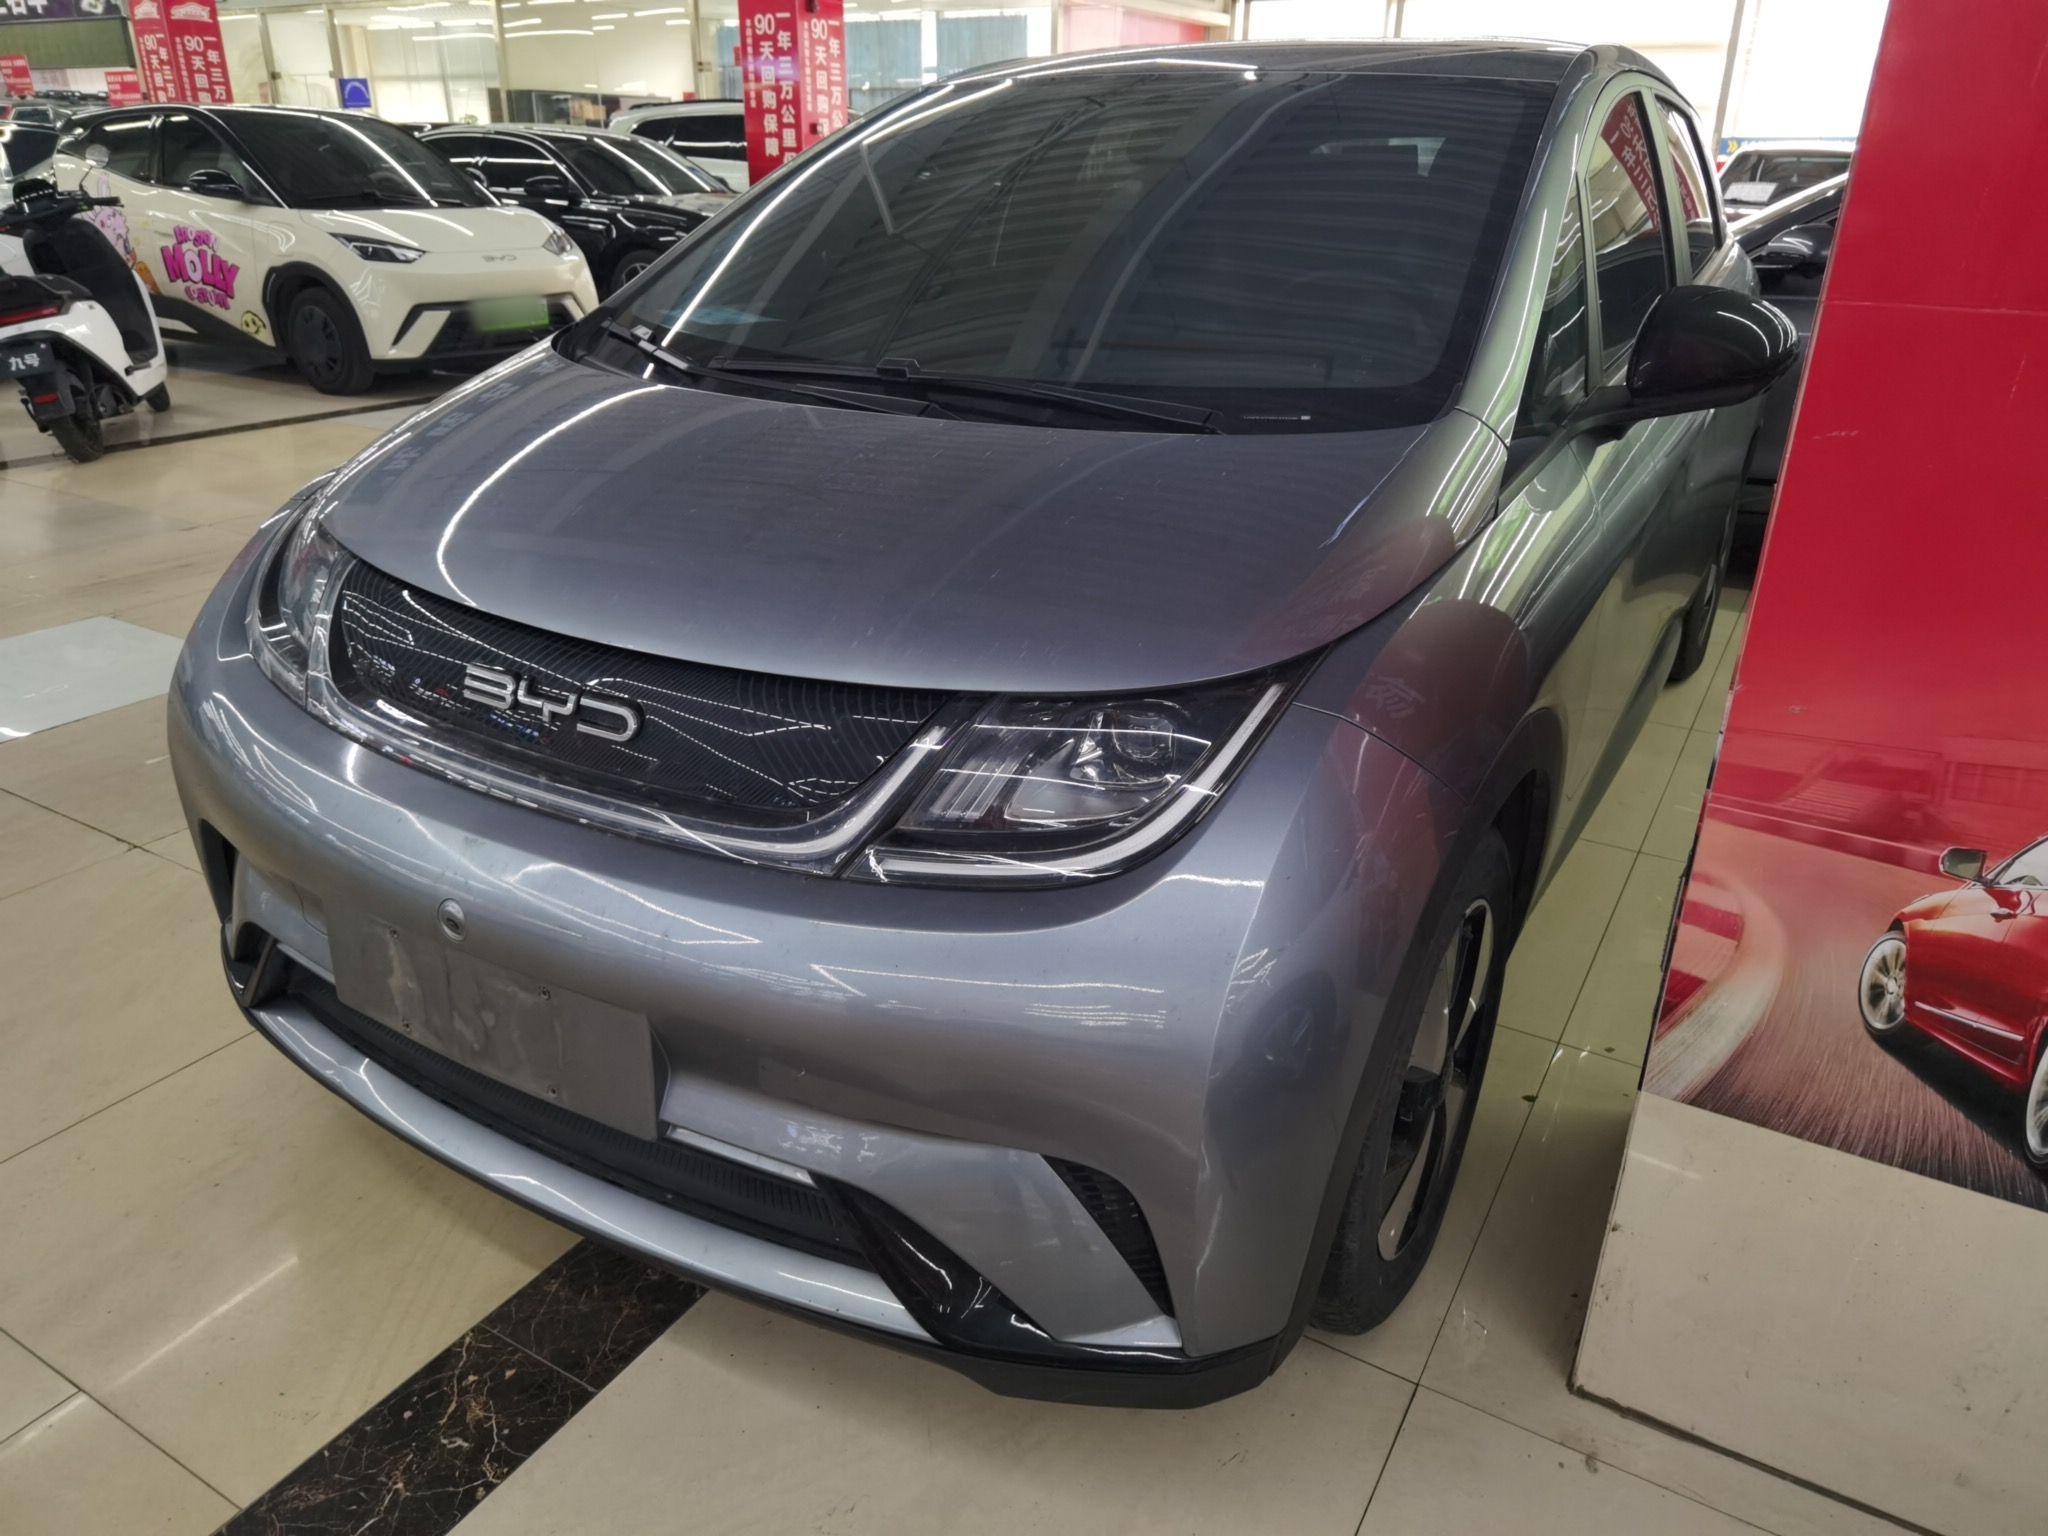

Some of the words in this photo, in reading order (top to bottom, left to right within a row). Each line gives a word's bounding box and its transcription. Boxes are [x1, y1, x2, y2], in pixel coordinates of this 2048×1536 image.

[161, 243, 240, 300] MOLLY
[8, 353, 40, 371] 九号
[463, 663, 638, 742] BYD
